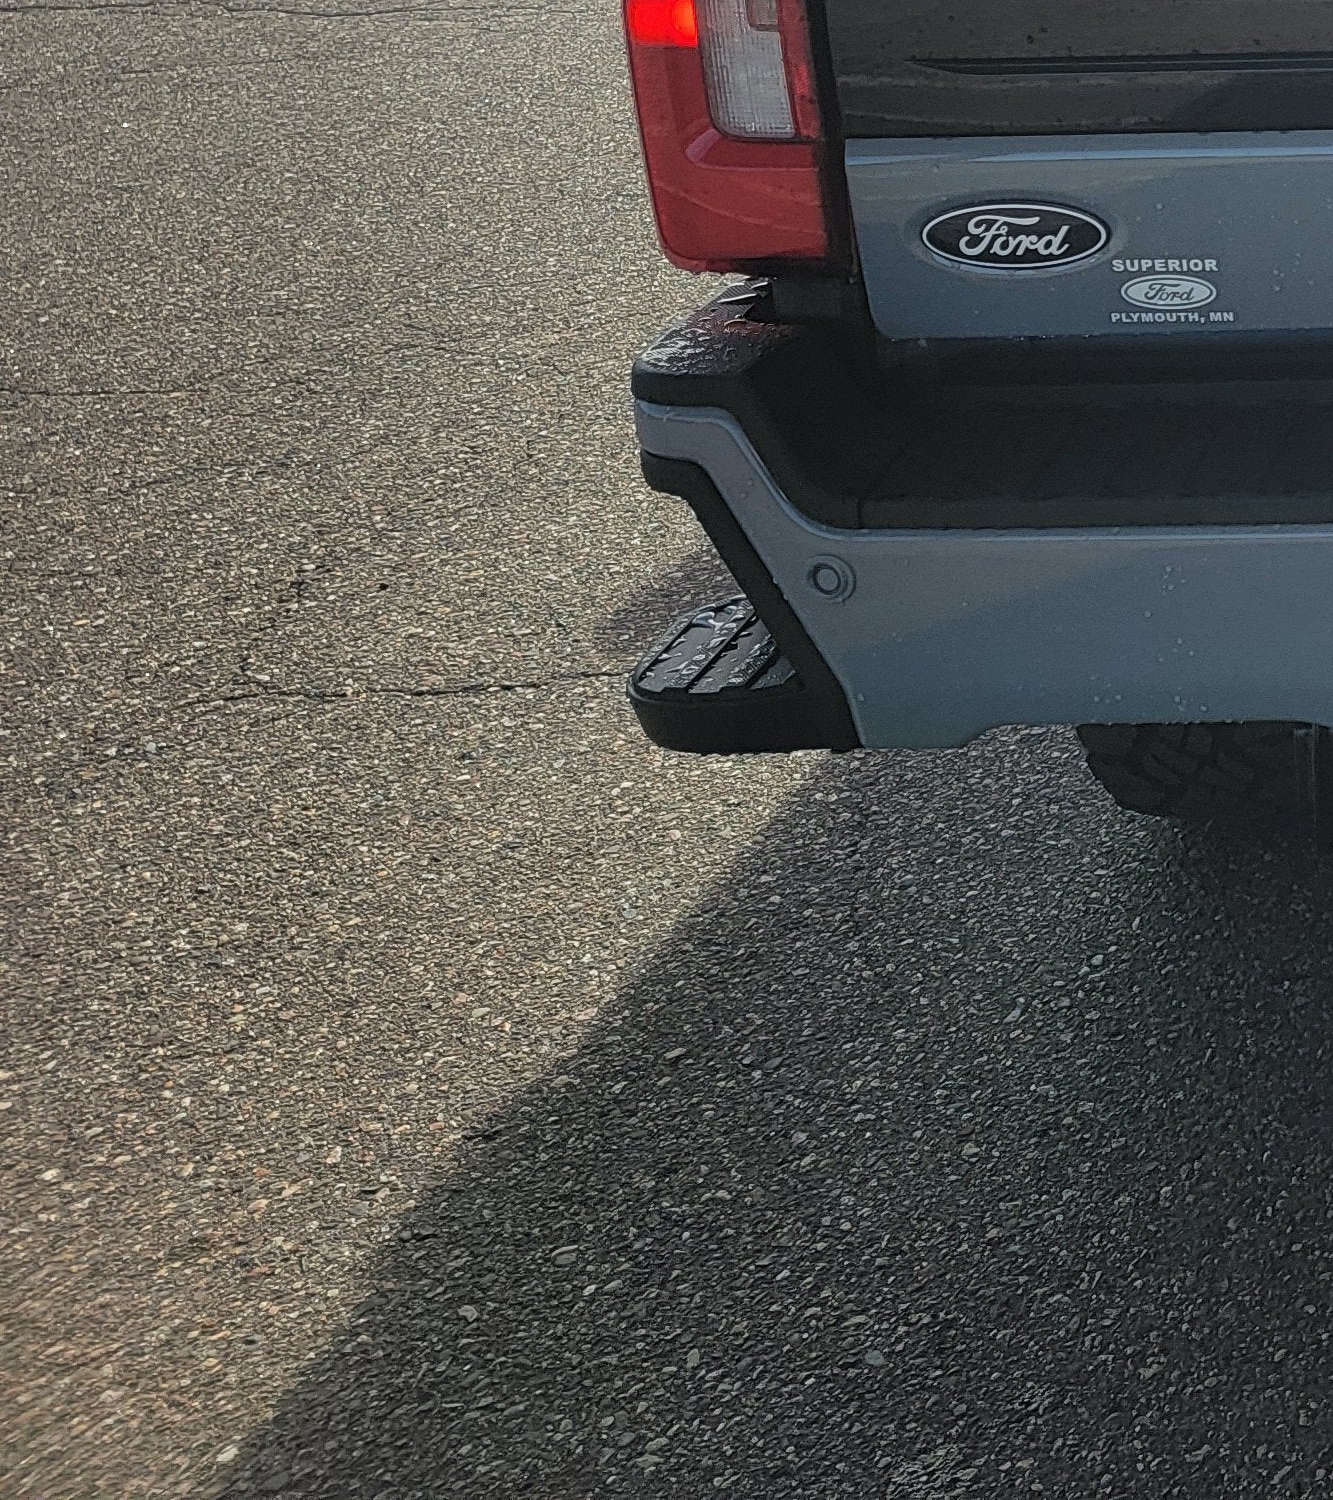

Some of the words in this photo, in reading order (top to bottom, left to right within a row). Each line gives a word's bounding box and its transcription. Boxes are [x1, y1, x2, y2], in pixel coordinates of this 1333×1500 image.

[958, 214, 1071, 256] Ford
[1111, 259, 1219, 272] SUPERIOR
[1143, 282, 1195, 302] Ford
[1110, 312, 1206, 324] PLYMOUTH,
[1209, 311, 1234, 322] MN
